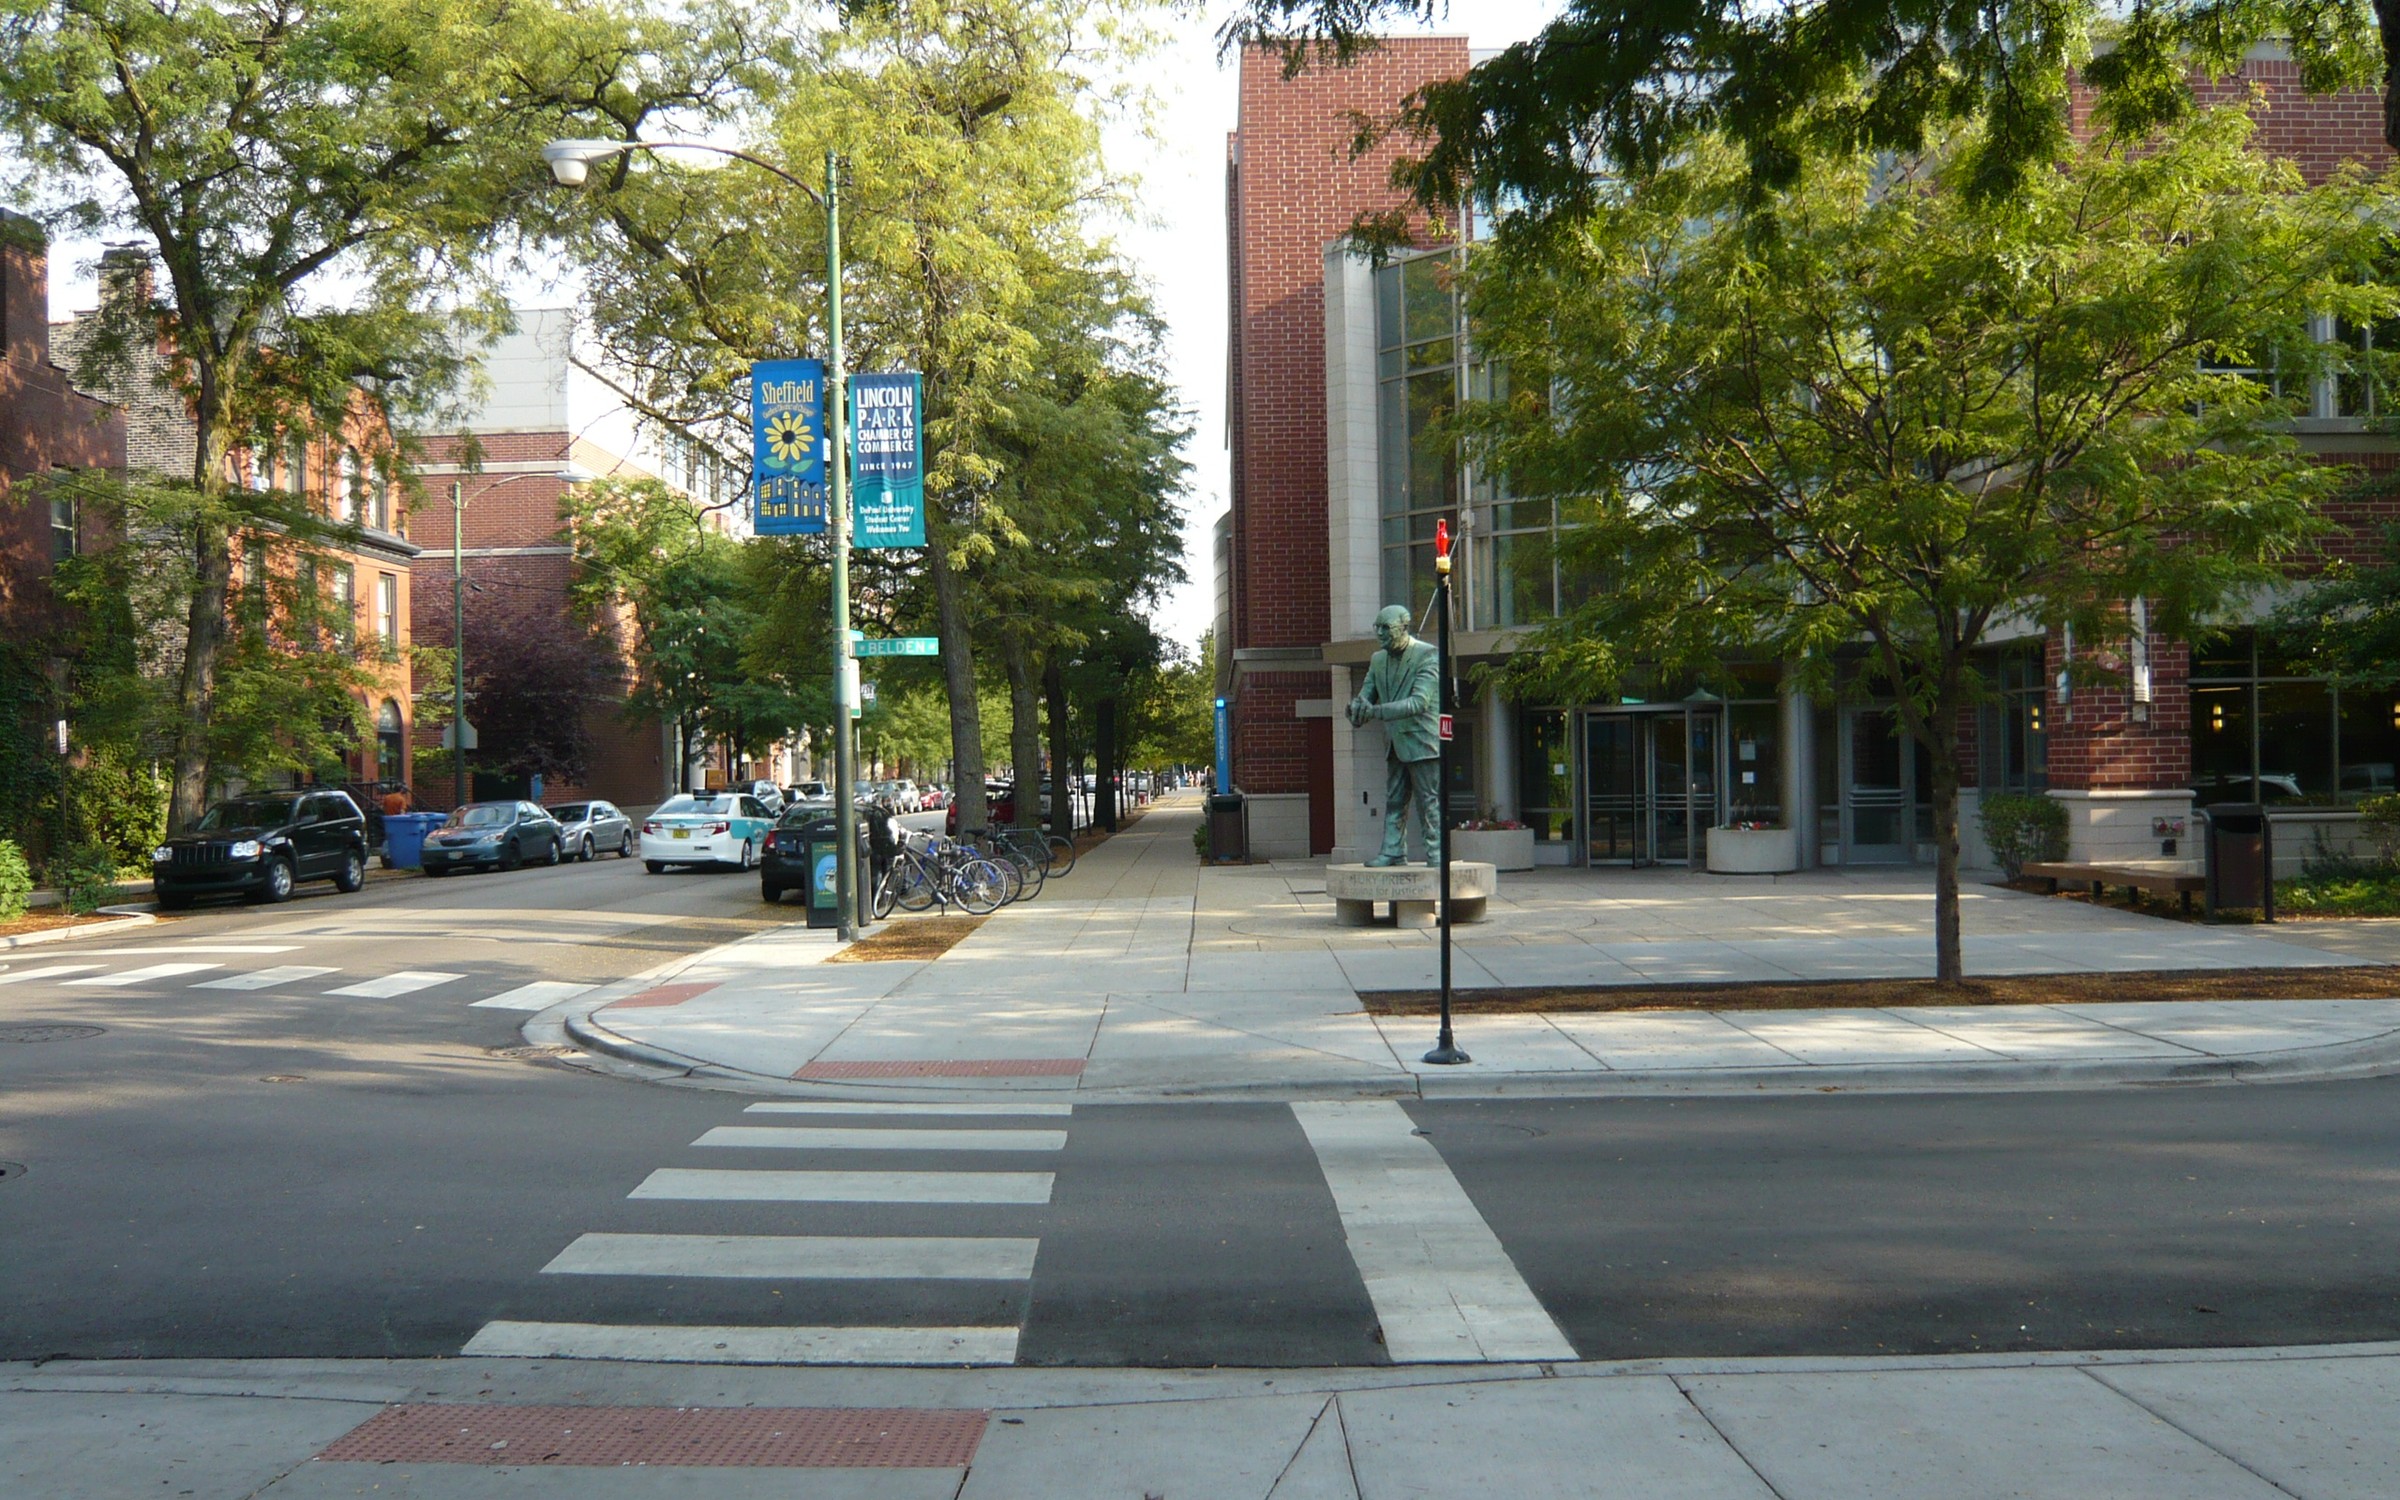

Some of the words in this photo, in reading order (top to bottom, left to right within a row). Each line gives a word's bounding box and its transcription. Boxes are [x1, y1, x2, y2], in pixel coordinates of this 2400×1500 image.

[762, 380, 814, 404] Sheffield
[857, 386, 912, 408] LINCOLN
[858, 428, 899, 441] CHAMBER
[902, 428, 913, 440] OF
[858, 440, 913, 453] COMMERCE
[860, 463, 885, 471] SINCE
[891, 461, 912, 470] 1947
[868, 641, 925, 655] BELDEN
